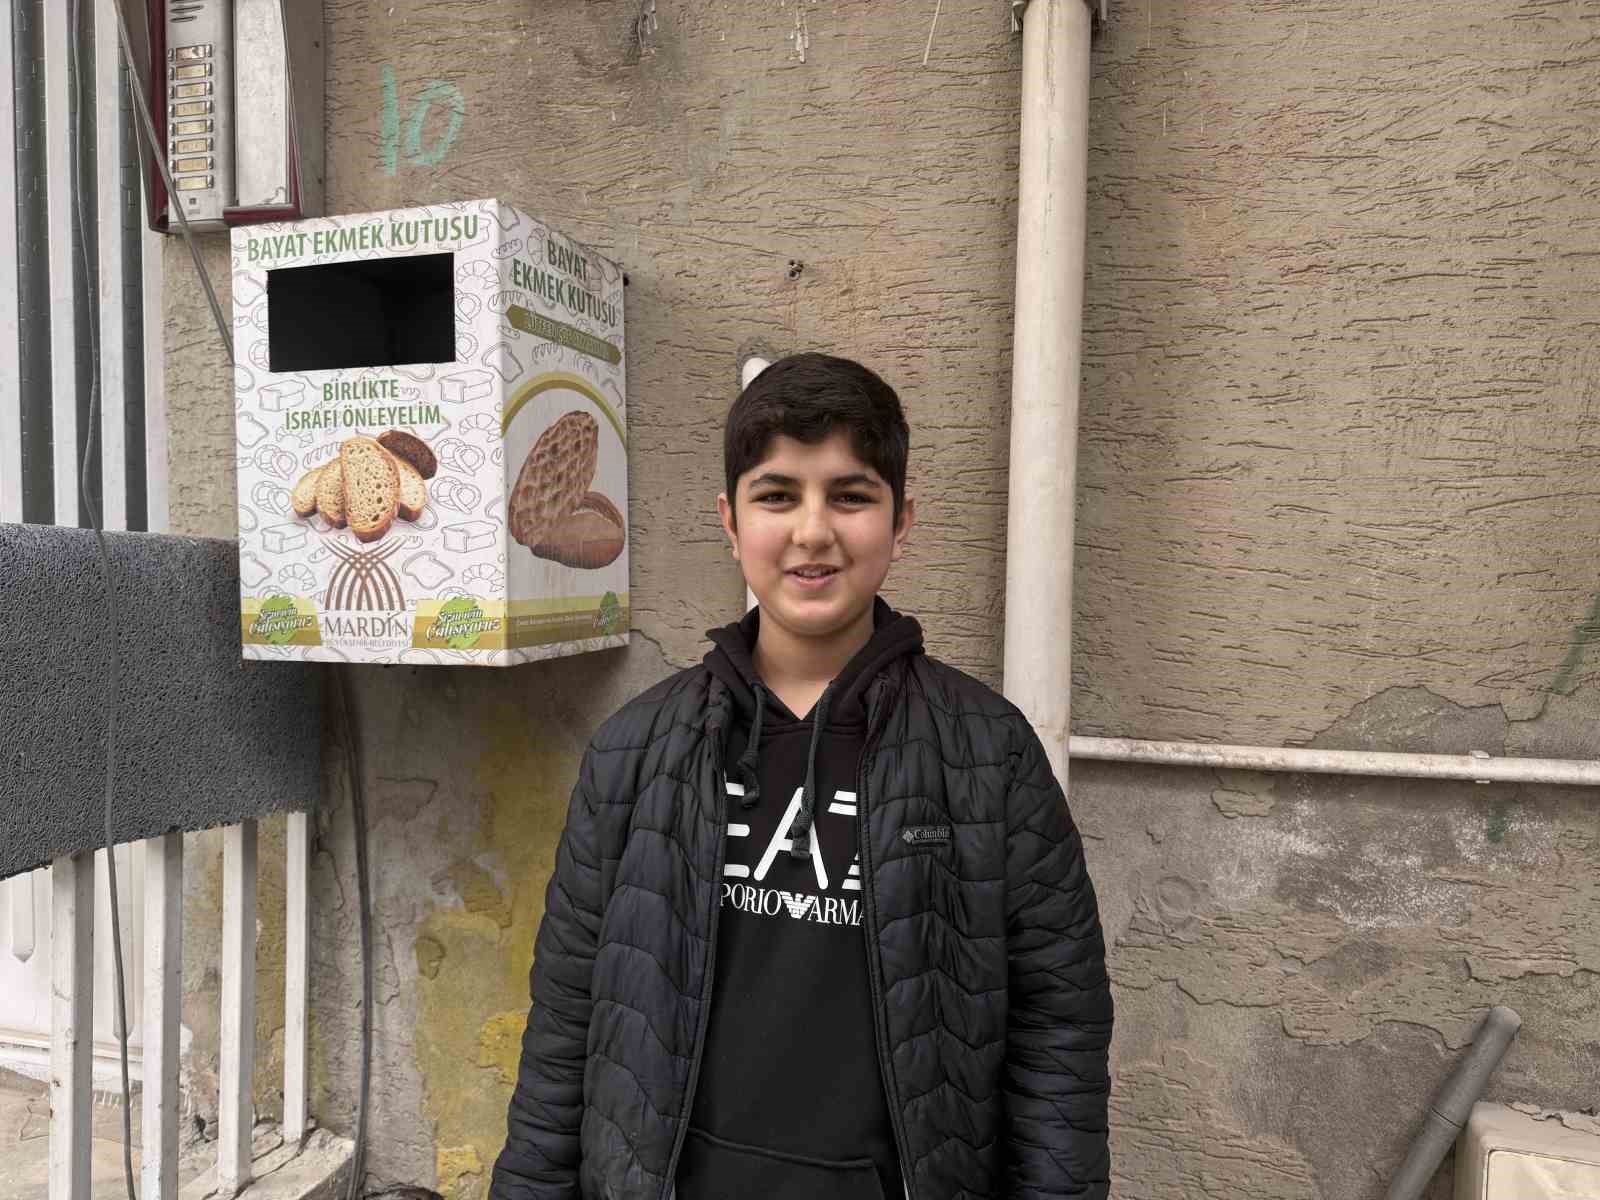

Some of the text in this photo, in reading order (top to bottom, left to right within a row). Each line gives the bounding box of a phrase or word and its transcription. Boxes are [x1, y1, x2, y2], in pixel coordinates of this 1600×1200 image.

[247, 214, 479, 262] BAYAT EKMEK KUTUSU
[547, 239, 588, 281] BAYAT
[512, 258, 616, 328] EKMEK KUTUSU
[323, 377, 399, 401] BİRLİKTE
[343, 401, 441, 427] ÖNLEYELİM
[325, 612, 408, 637] MARDİN
